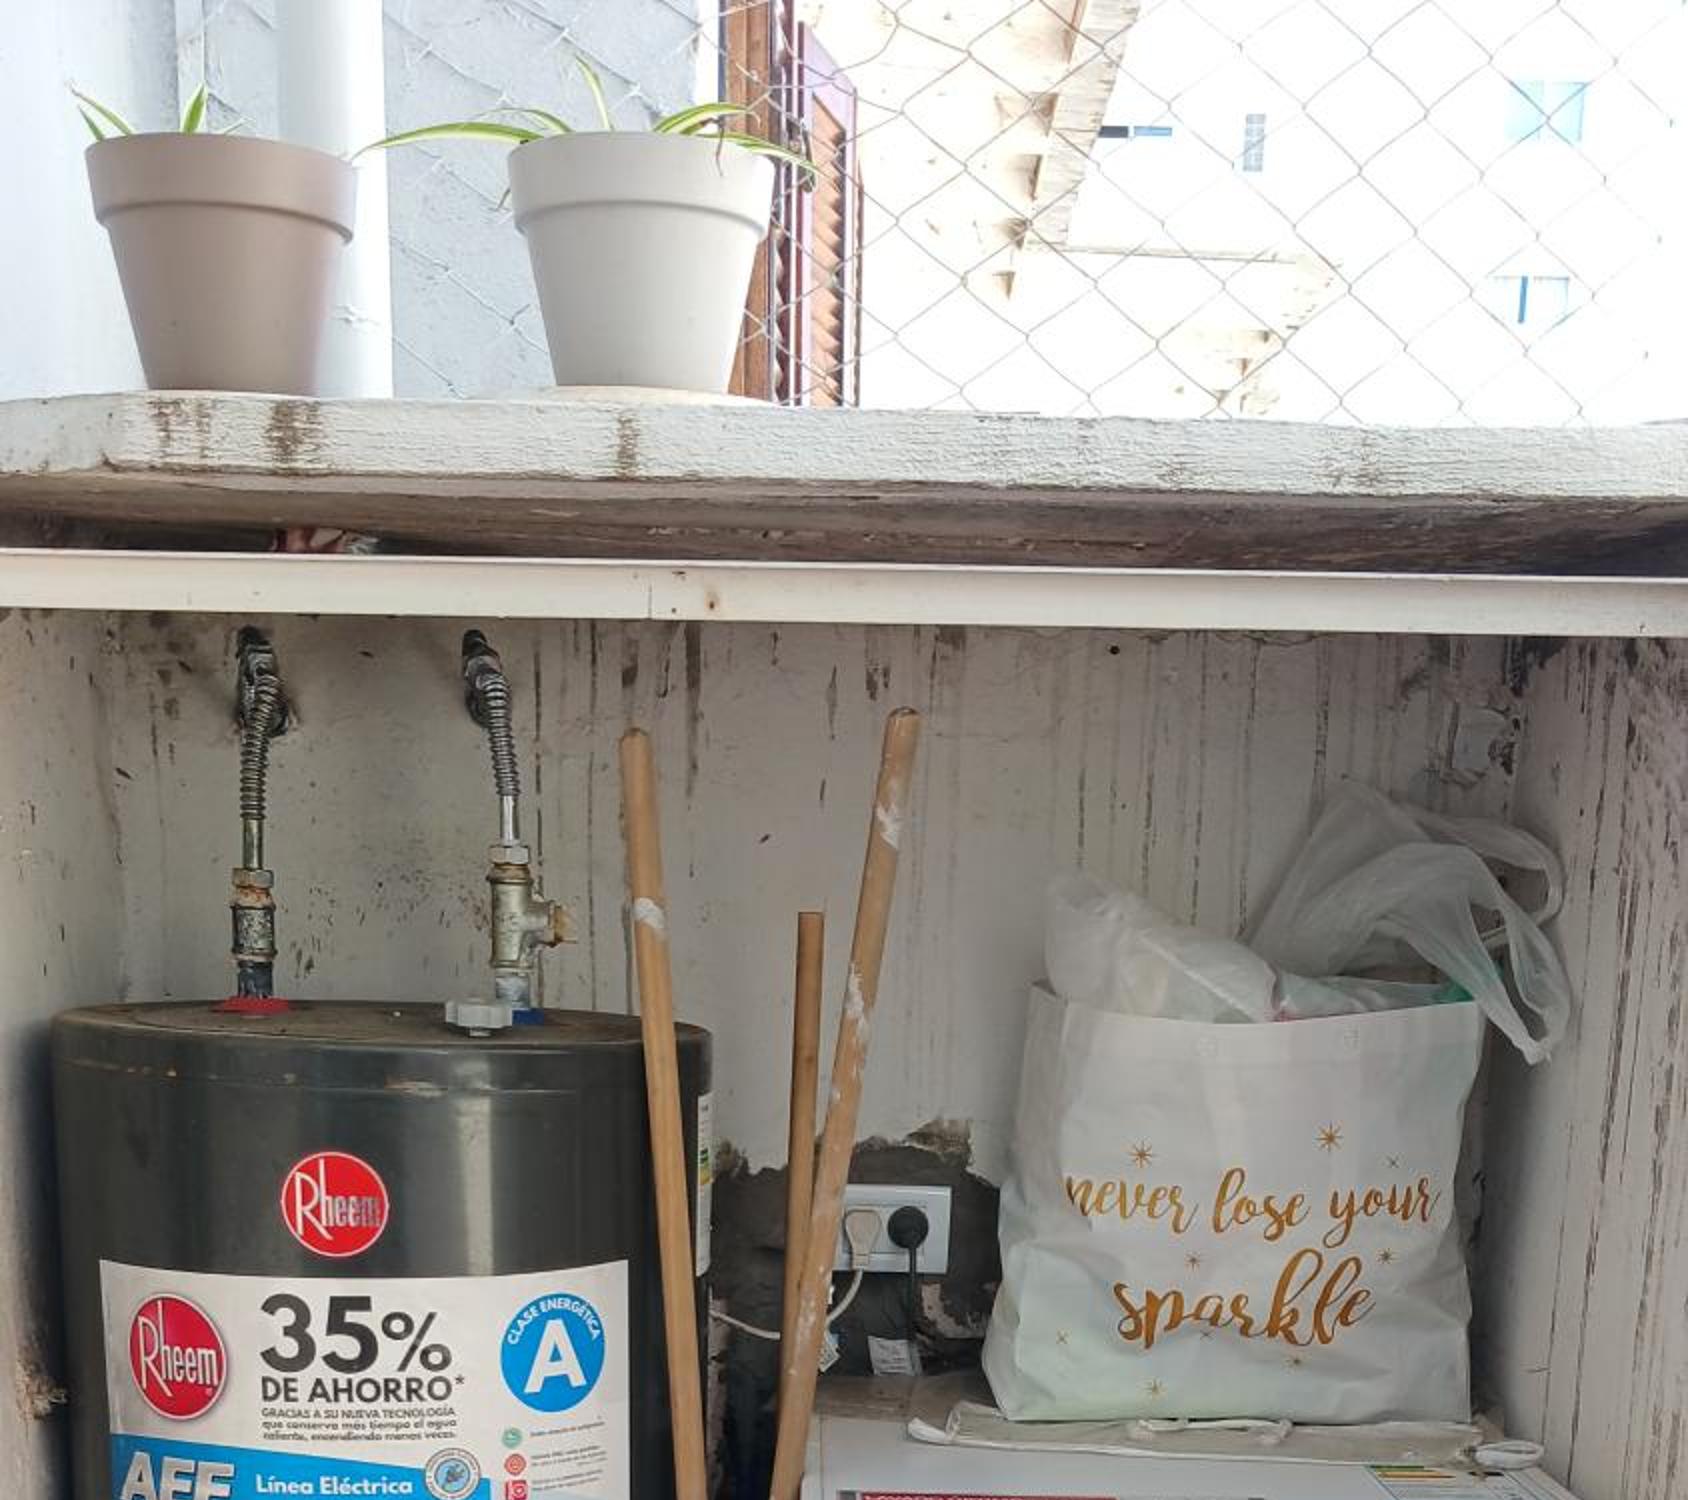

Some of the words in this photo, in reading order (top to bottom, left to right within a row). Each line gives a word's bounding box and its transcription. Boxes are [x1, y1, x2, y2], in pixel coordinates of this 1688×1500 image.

[294, 1158, 382, 1241] Rheem
[1065, 1175, 1200, 1235] never
[1211, 1167, 1312, 1241] lose
[1322, 1176, 1442, 1249] your
[260, 1293, 452, 1374] 35%
[507, 1305, 540, 1345] CLASE
[1112, 1247, 1377, 1350] sparkle
[137, 1300, 219, 1398] Rheem
[523, 1318, 588, 1394] A
[261, 1375, 299, 1402] DE
[261, 1407, 313, 1419] GRACIAS
[313, 1409, 322, 1418] A
[324, 1409, 338, 1419] SU
[341, 1409, 381, 1419] NUEVA
[256, 1473, 315, 1494] Línea
[320, 1475, 413, 1495] Eléctrica
